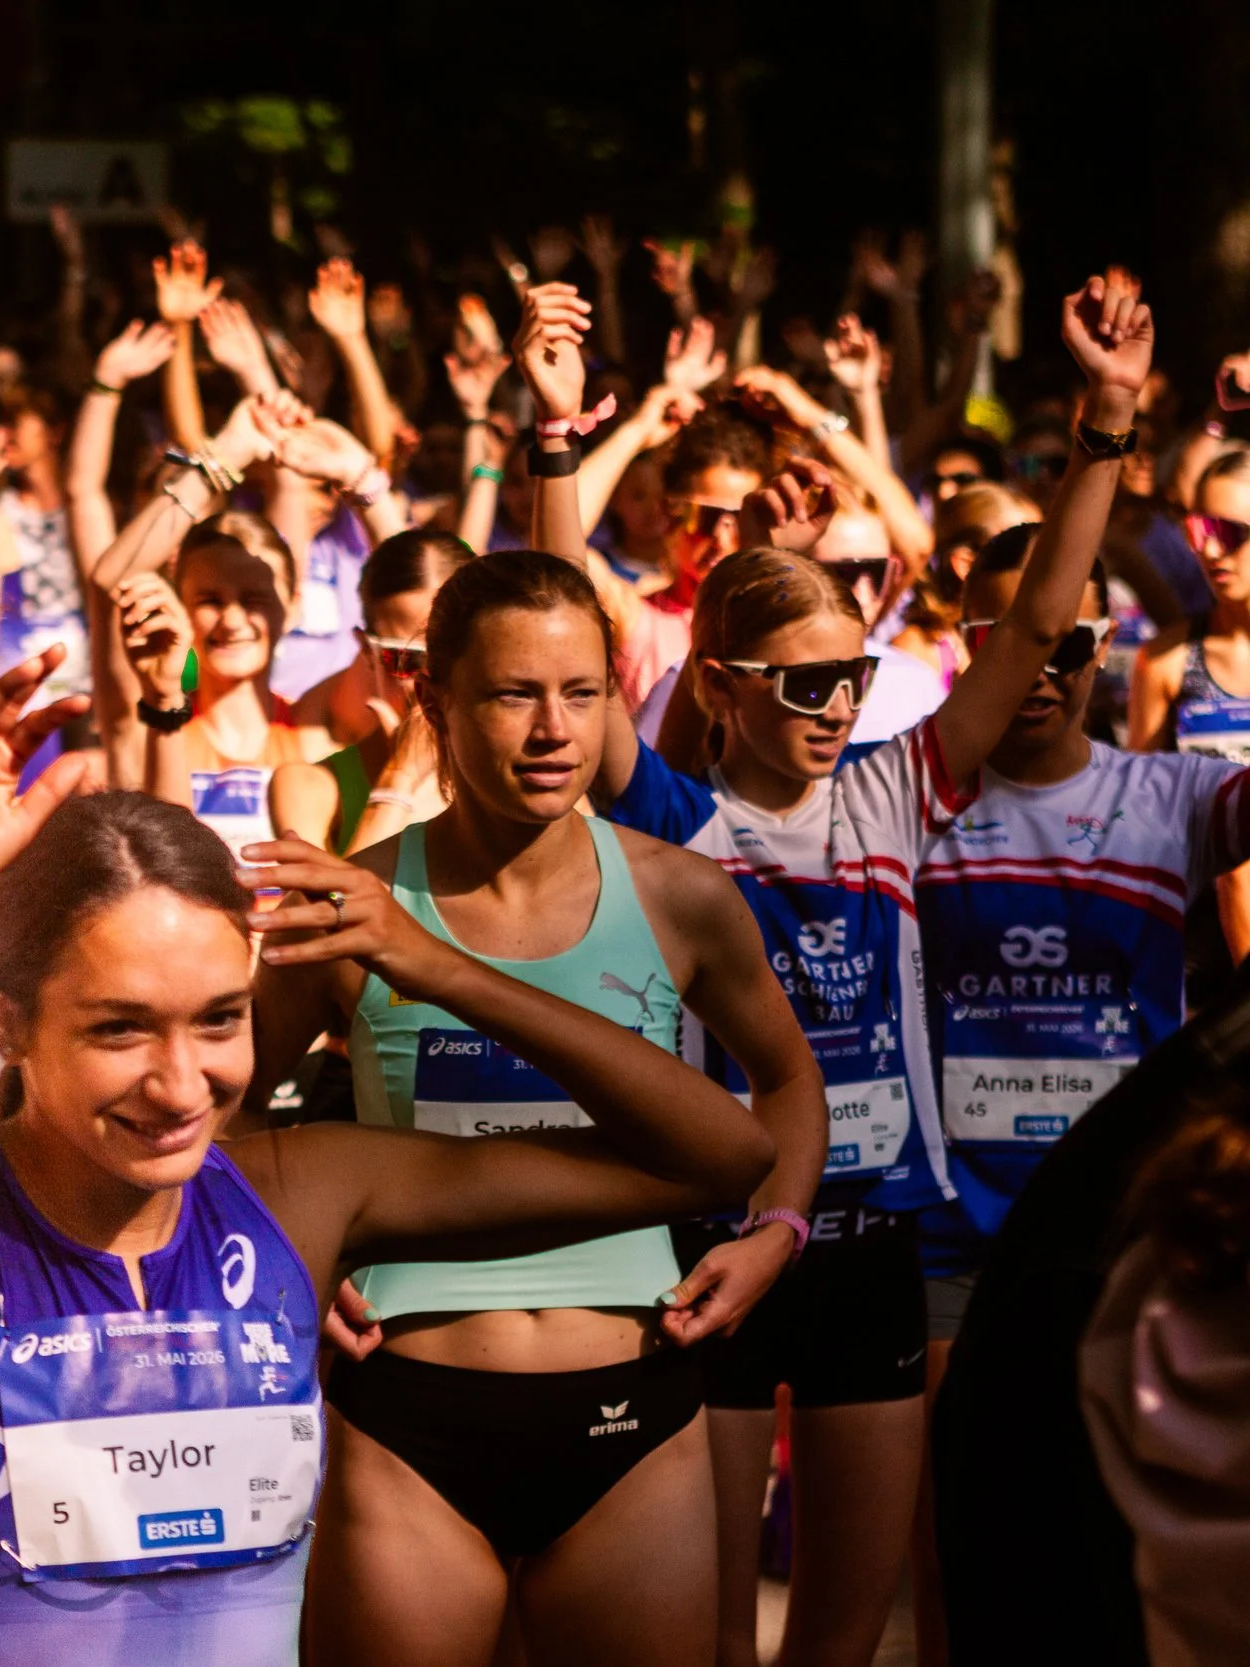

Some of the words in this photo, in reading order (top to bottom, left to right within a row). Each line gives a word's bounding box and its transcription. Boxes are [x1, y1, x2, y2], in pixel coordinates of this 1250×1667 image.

[958, 973, 1113, 998] GARTNER
[445, 1042, 483, 1055] asics
[972, 1074, 1033, 1094] Anna
[1041, 1073, 1093, 1093] Elisa
[964, 1102, 987, 1118] 45
[38, 1333, 91, 1357] asics
[157, 1352, 186, 1367] MAI
[188, 1350, 226, 1366] 2026
[589, 1419, 639, 1437] erima
[101, 1440, 216, 1479] Taylor
[249, 1478, 279, 1492] Elite
[52, 1501, 70, 1524] 5
[146, 1520, 200, 1541] ERSTE
